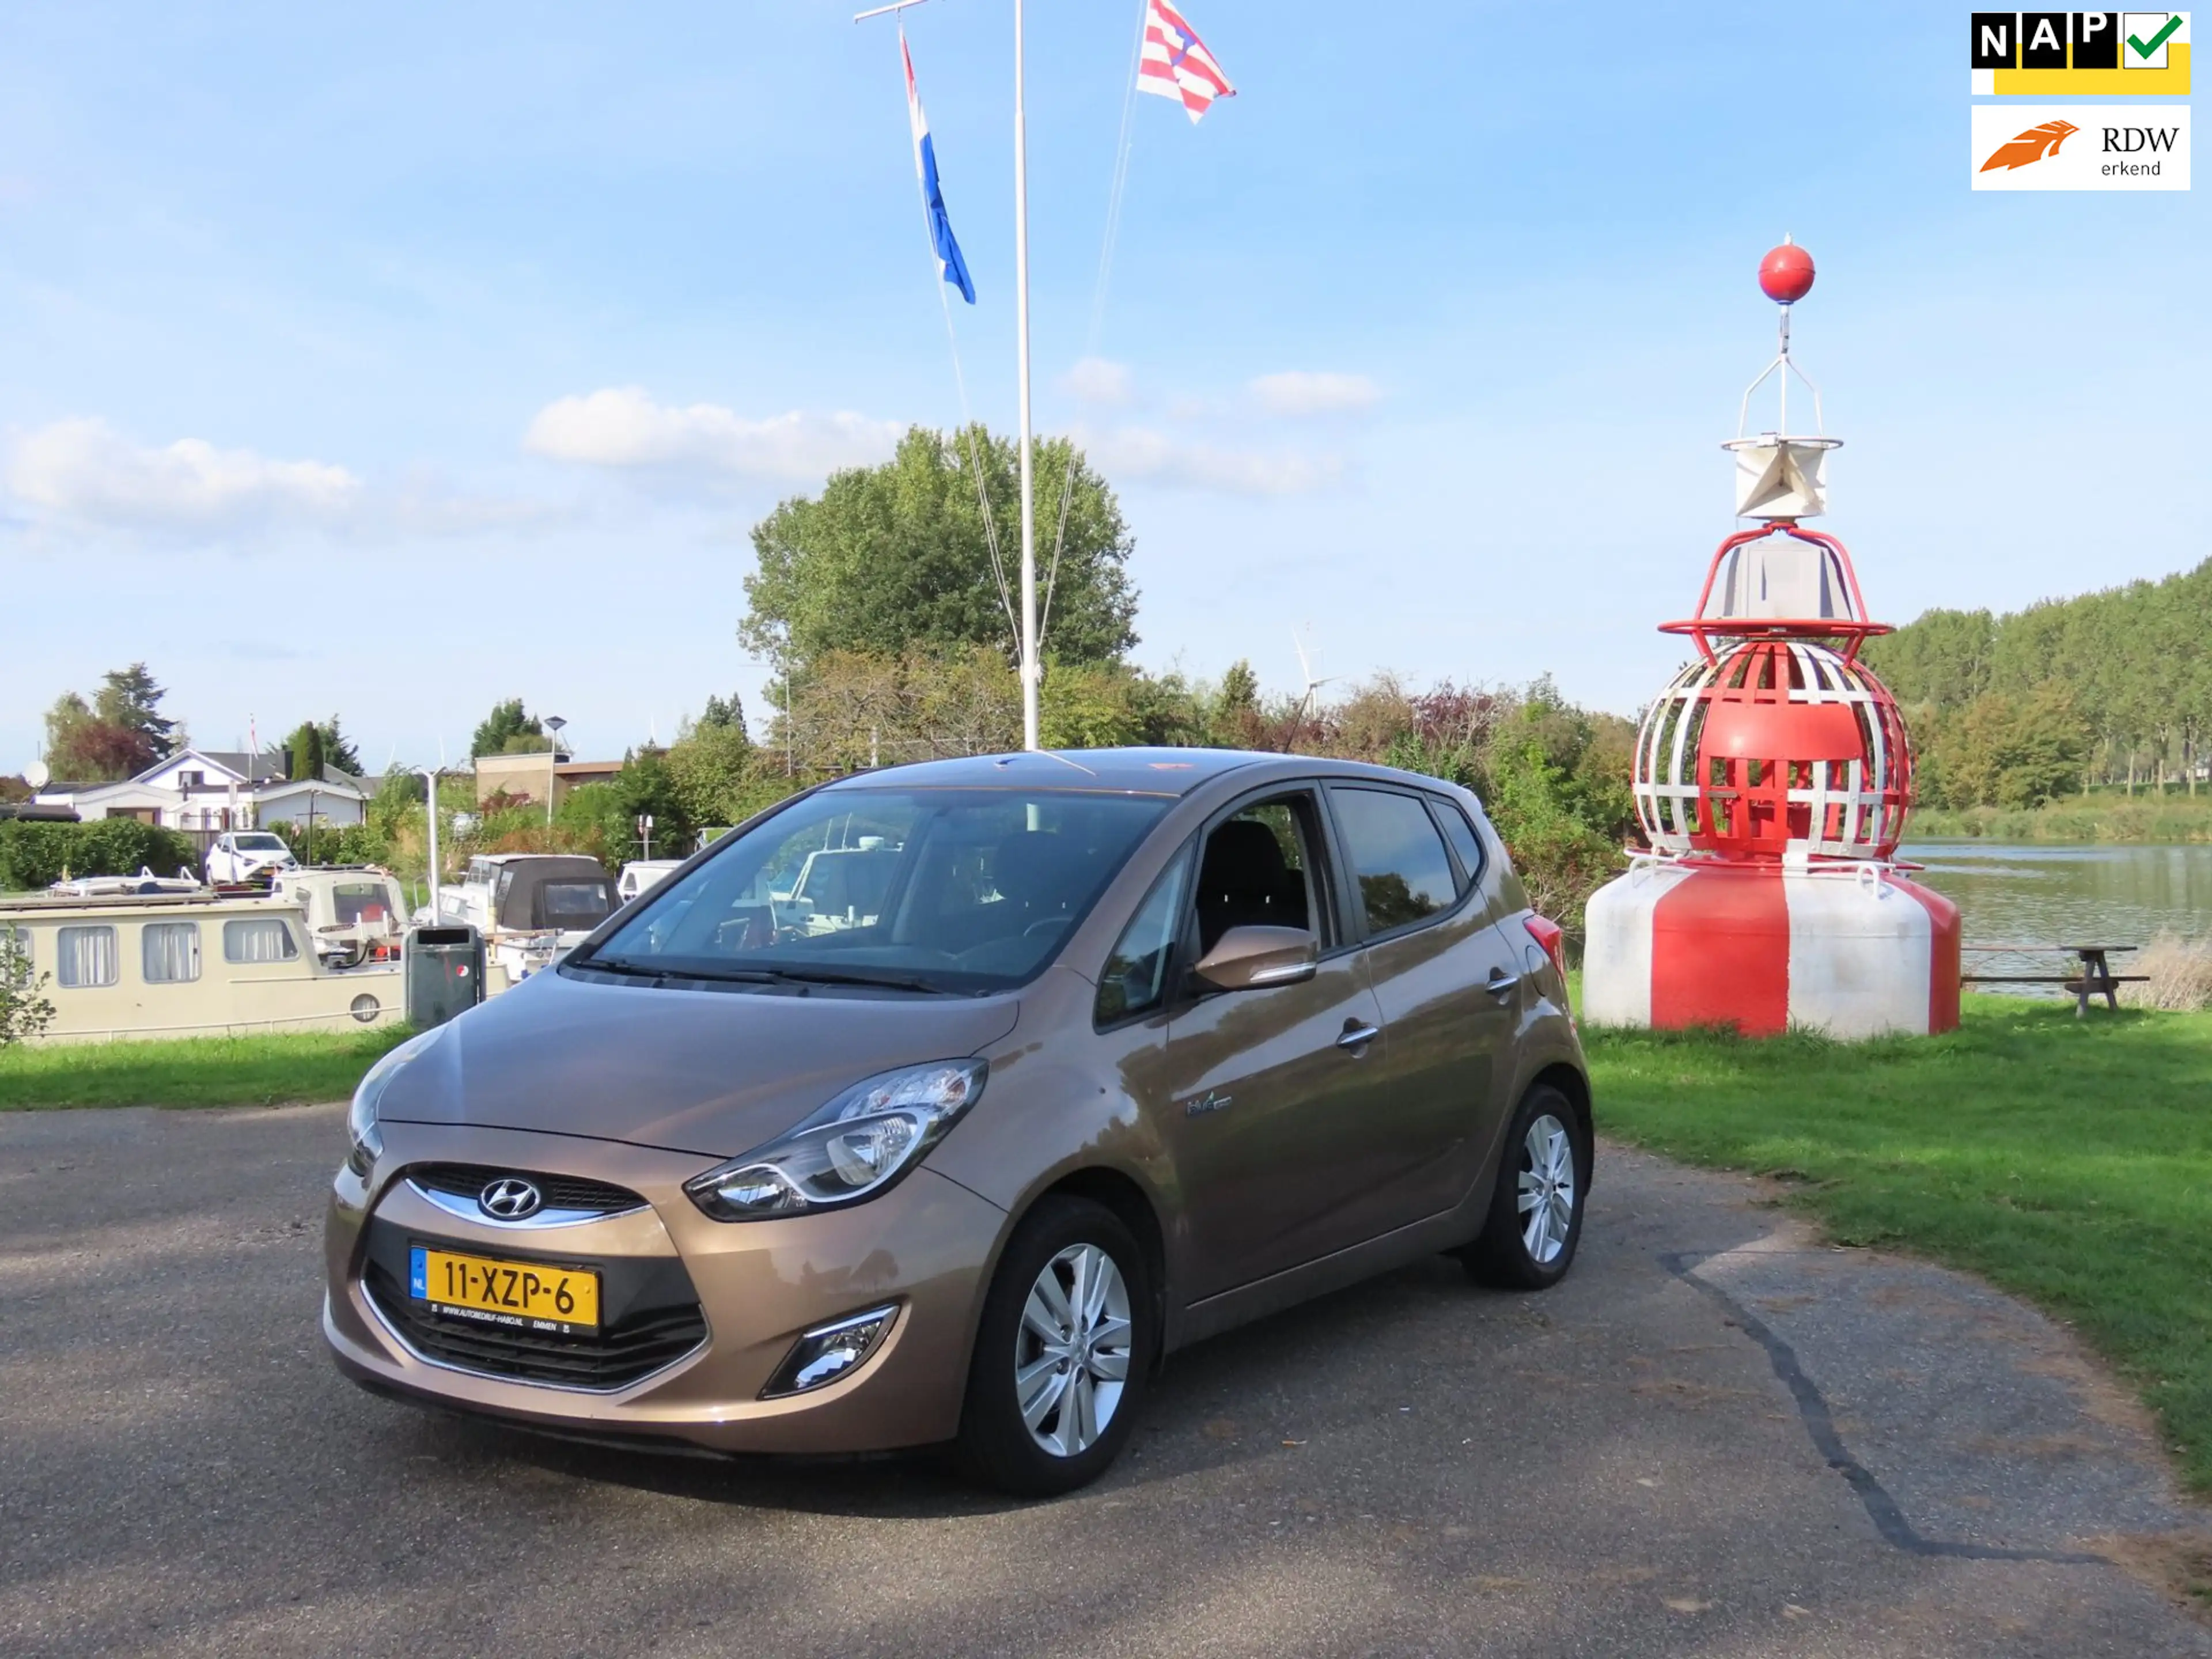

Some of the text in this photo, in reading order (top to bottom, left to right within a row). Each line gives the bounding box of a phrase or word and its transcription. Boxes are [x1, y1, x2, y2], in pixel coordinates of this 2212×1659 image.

[414, 1278, 425, 1290] NL
[445, 1261, 574, 1315] 11-XZP-6
[533, 1320, 557, 1331] EMMEN
